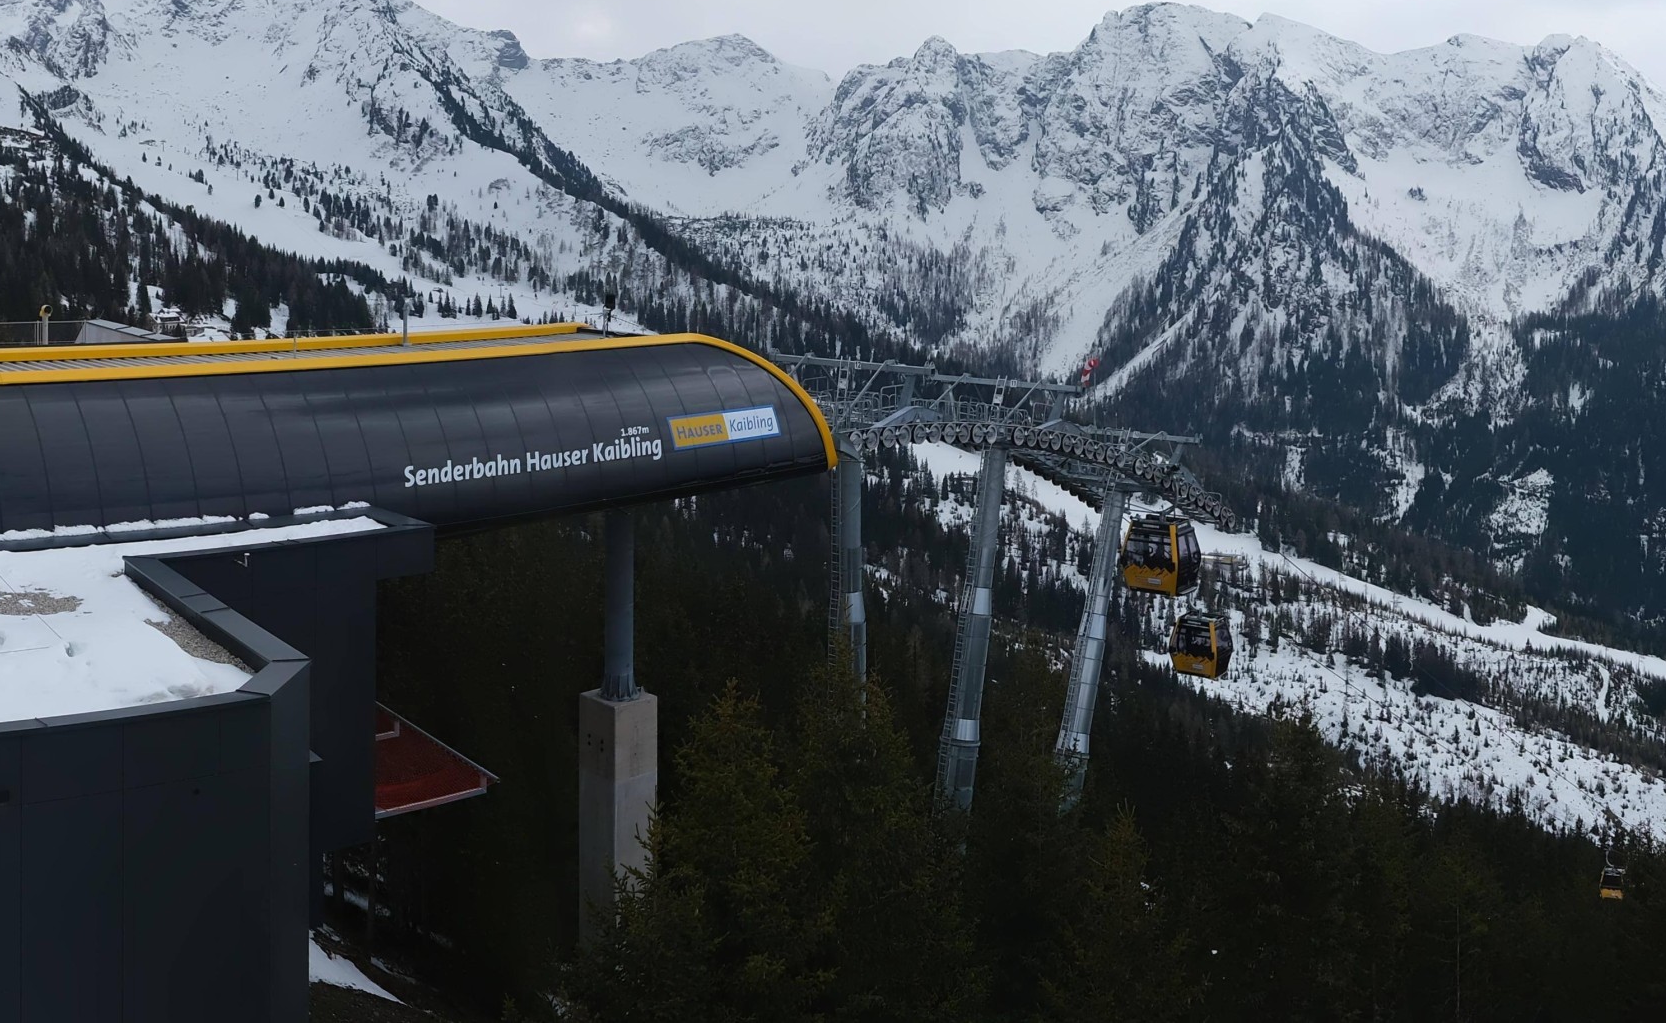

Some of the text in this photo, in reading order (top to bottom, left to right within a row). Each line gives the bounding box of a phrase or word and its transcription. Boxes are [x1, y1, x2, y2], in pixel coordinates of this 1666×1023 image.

[620, 425, 650, 438] 1.867m
[676, 416, 774, 441] HAUSER Kaibling
[403, 436, 663, 487] Senderbahn Hauser Kaibling
